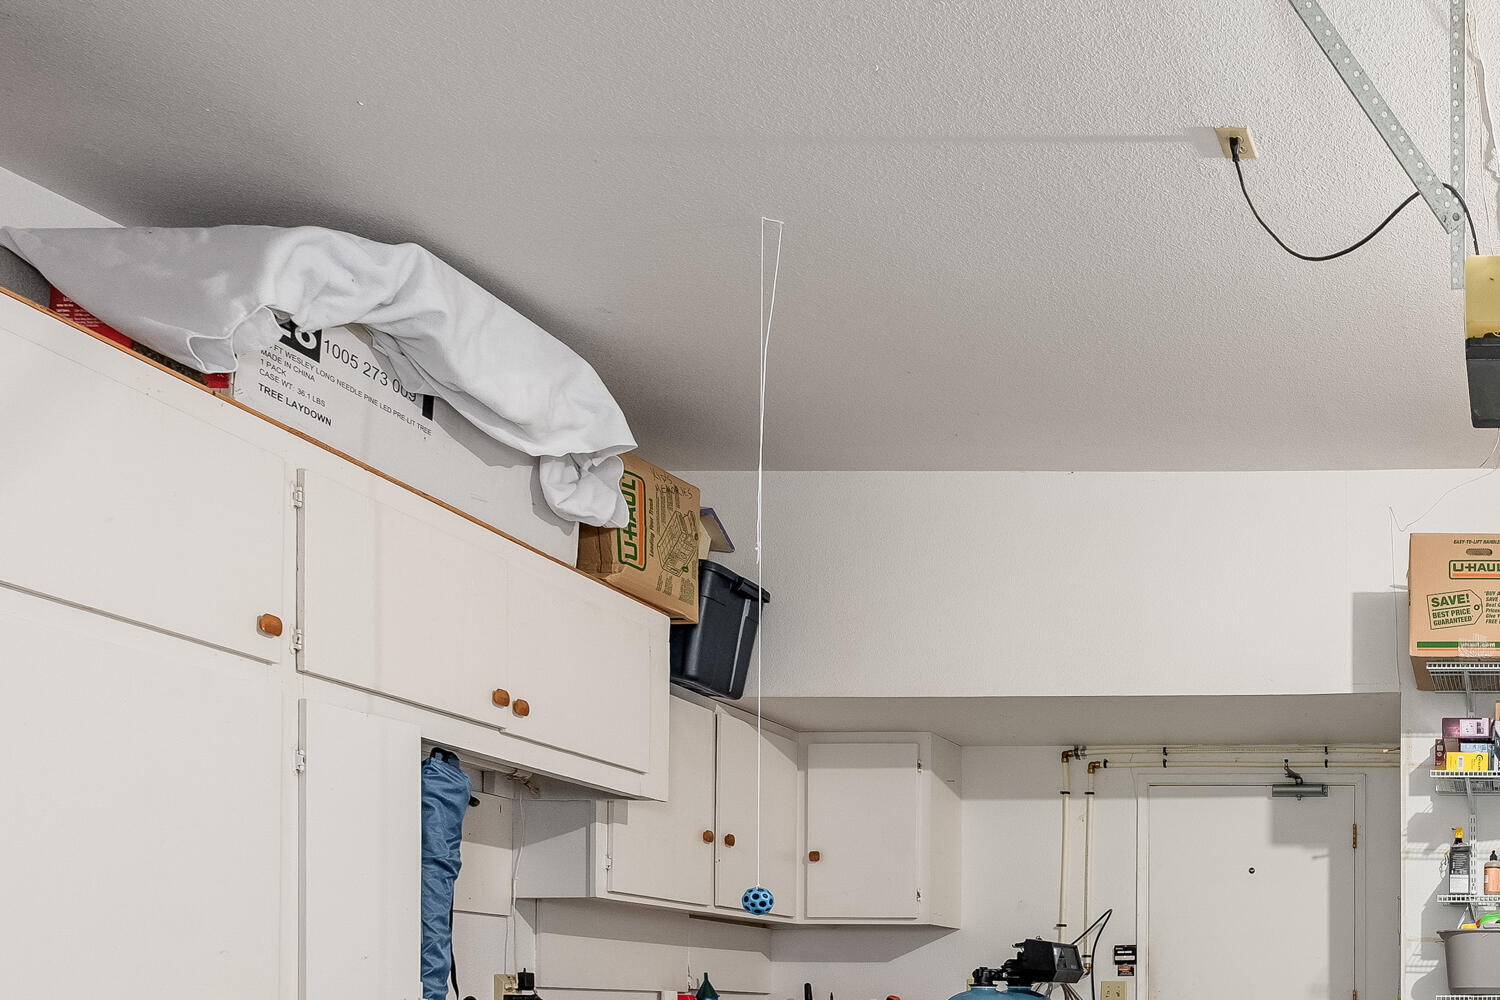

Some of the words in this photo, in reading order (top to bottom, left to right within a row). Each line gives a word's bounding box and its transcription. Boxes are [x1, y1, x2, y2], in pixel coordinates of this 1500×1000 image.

[261, 349, 282, 367] MADE
[284, 361, 291, 371] IN
[292, 365, 315, 382] CHINA
[266, 361, 287, 377] PACK
[324, 340, 359, 370] 1005
[363, 362, 388, 387] 273
[258, 383, 283, 403] TREE
[285, 396, 332, 427] LAYDOWN
[259, 368, 280, 384] CASE
[312, 393, 326, 408] LBS
[284, 349, 315, 371] WESLEY
[315, 365, 335, 383] LONG
[336, 377, 363, 398] NEEDLE
[363, 393, 379, 408] PINE
[380, 402, 392, 414] LED
[393, 409, 415, 427] PRE-LIT
[416, 421, 432, 436] TREE
[1431, 594, 1470, 607] SAVE!
[1451, 608, 1471, 616] PRICE
